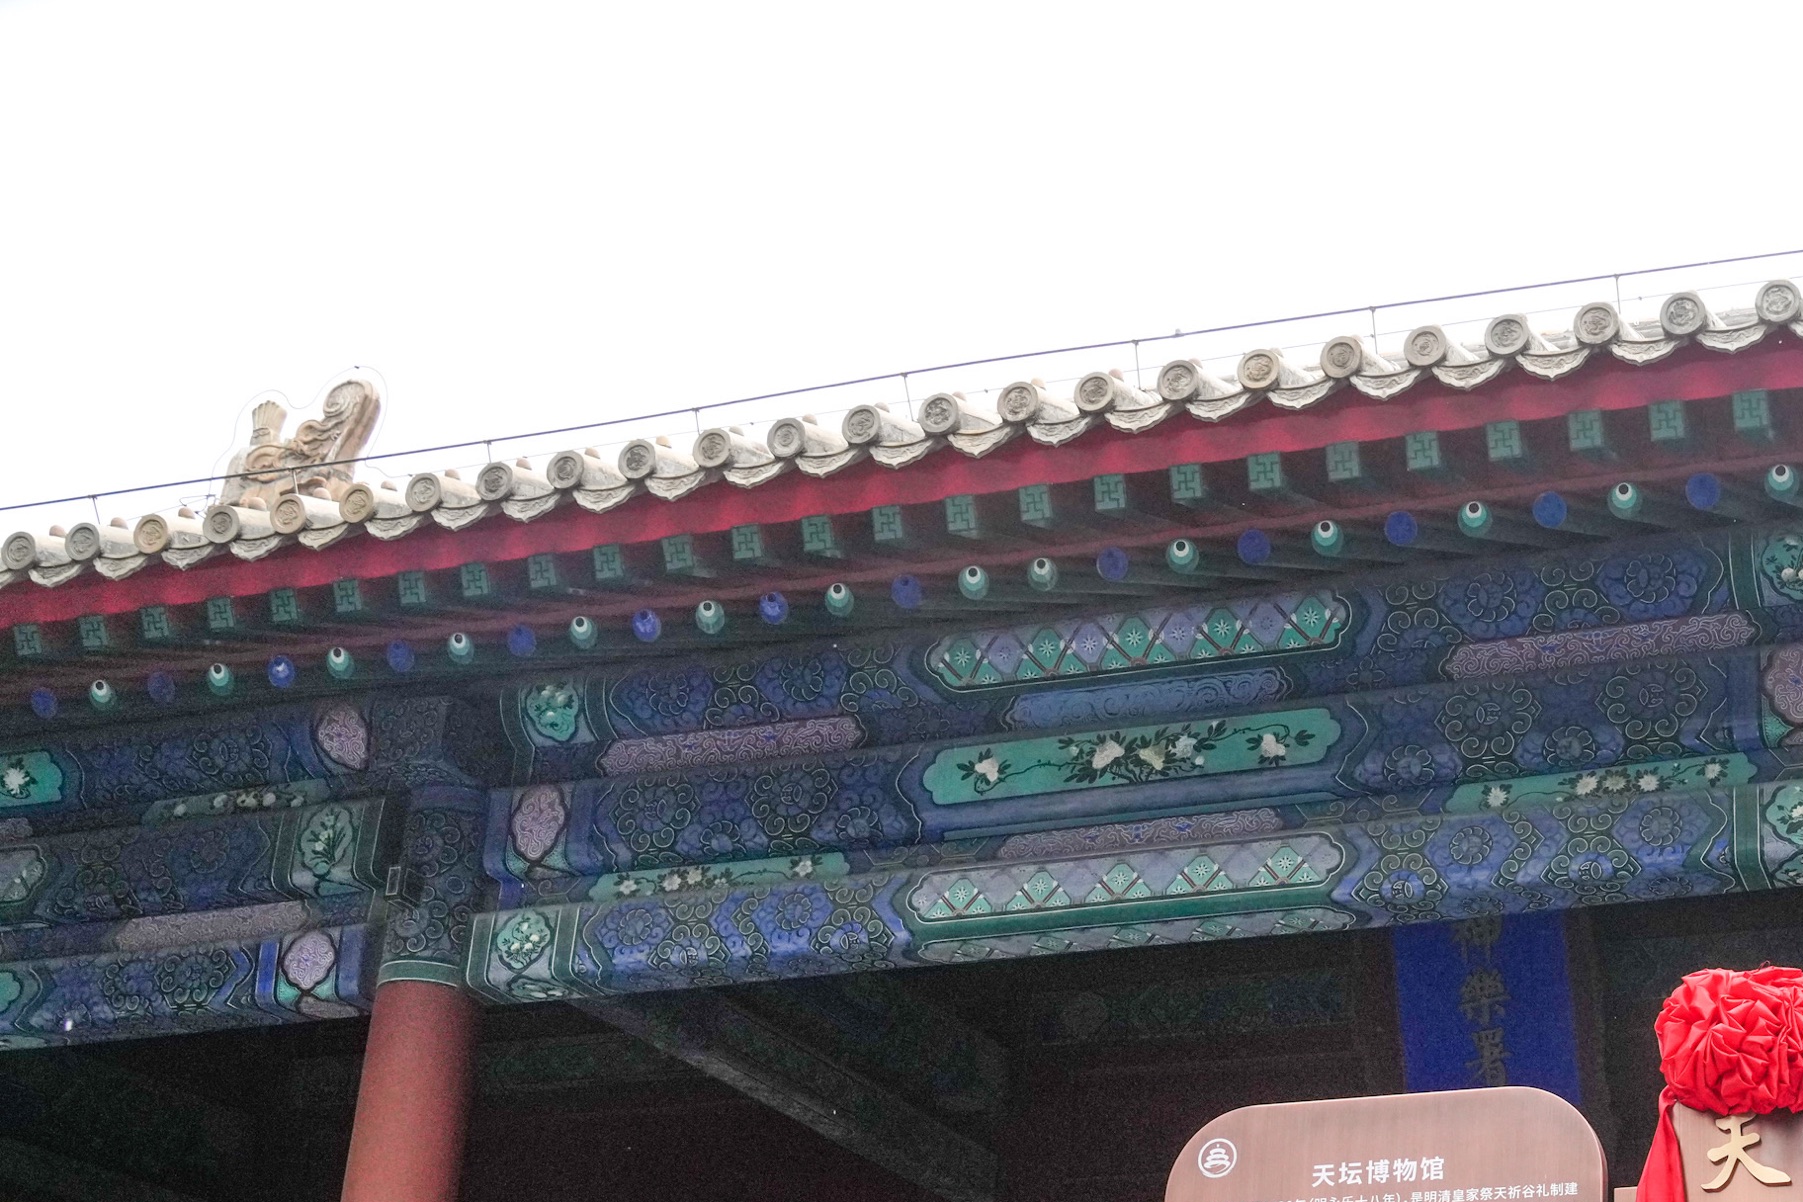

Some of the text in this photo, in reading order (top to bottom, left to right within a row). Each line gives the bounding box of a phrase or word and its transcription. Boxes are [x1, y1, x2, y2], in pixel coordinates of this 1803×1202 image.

[1311, 1155, 1444, 1187] 天坛博物馆
